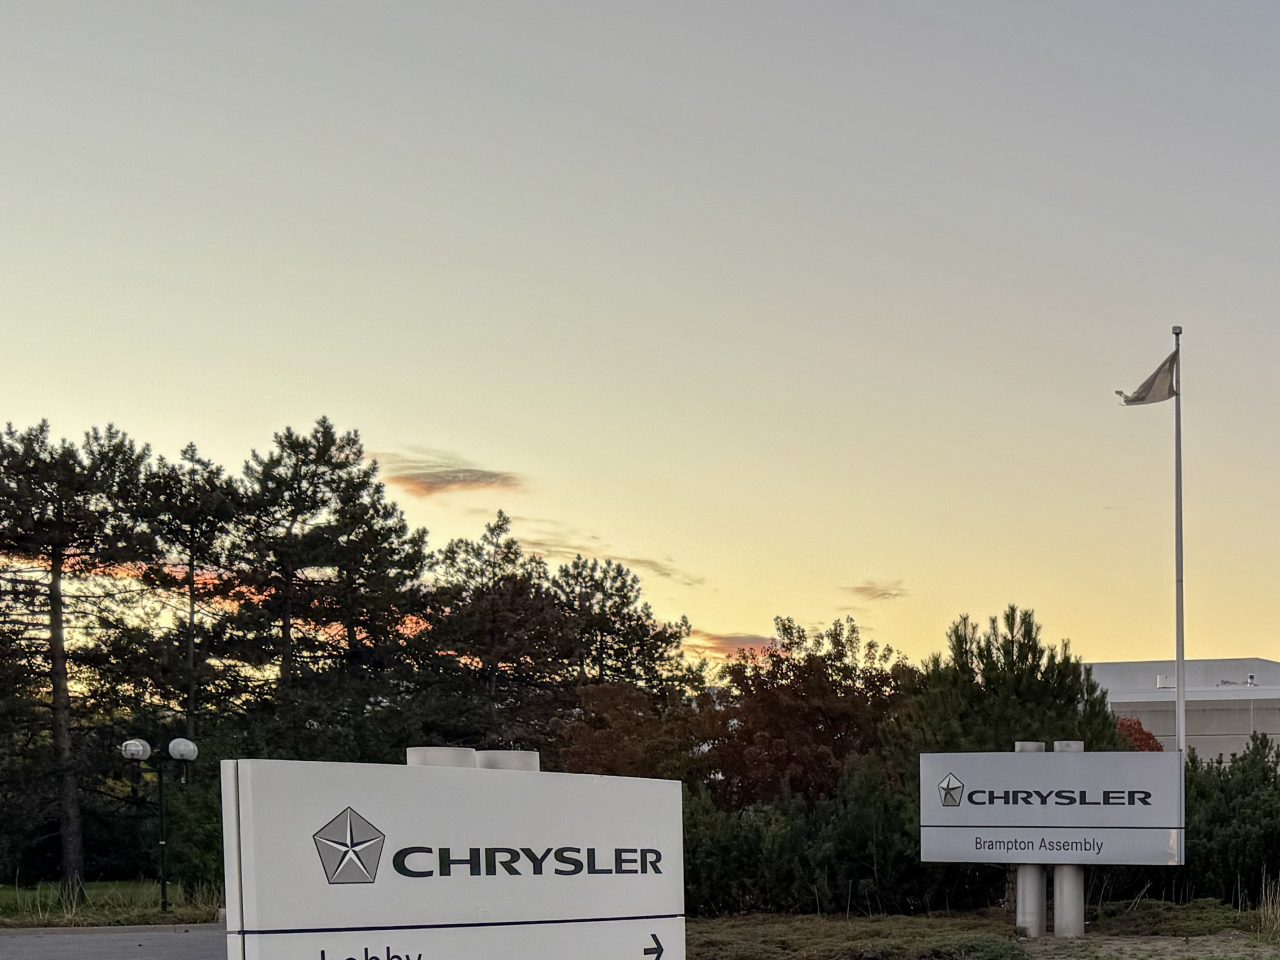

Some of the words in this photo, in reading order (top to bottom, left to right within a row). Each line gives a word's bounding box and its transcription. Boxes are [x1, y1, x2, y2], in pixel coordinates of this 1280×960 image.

[968, 790, 1151, 805] CHRYSLER
[976, 837, 1033, 853] Brampton
[1039, 838, 1104, 855] Assembly
[393, 847, 662, 877] CHRYSLER
